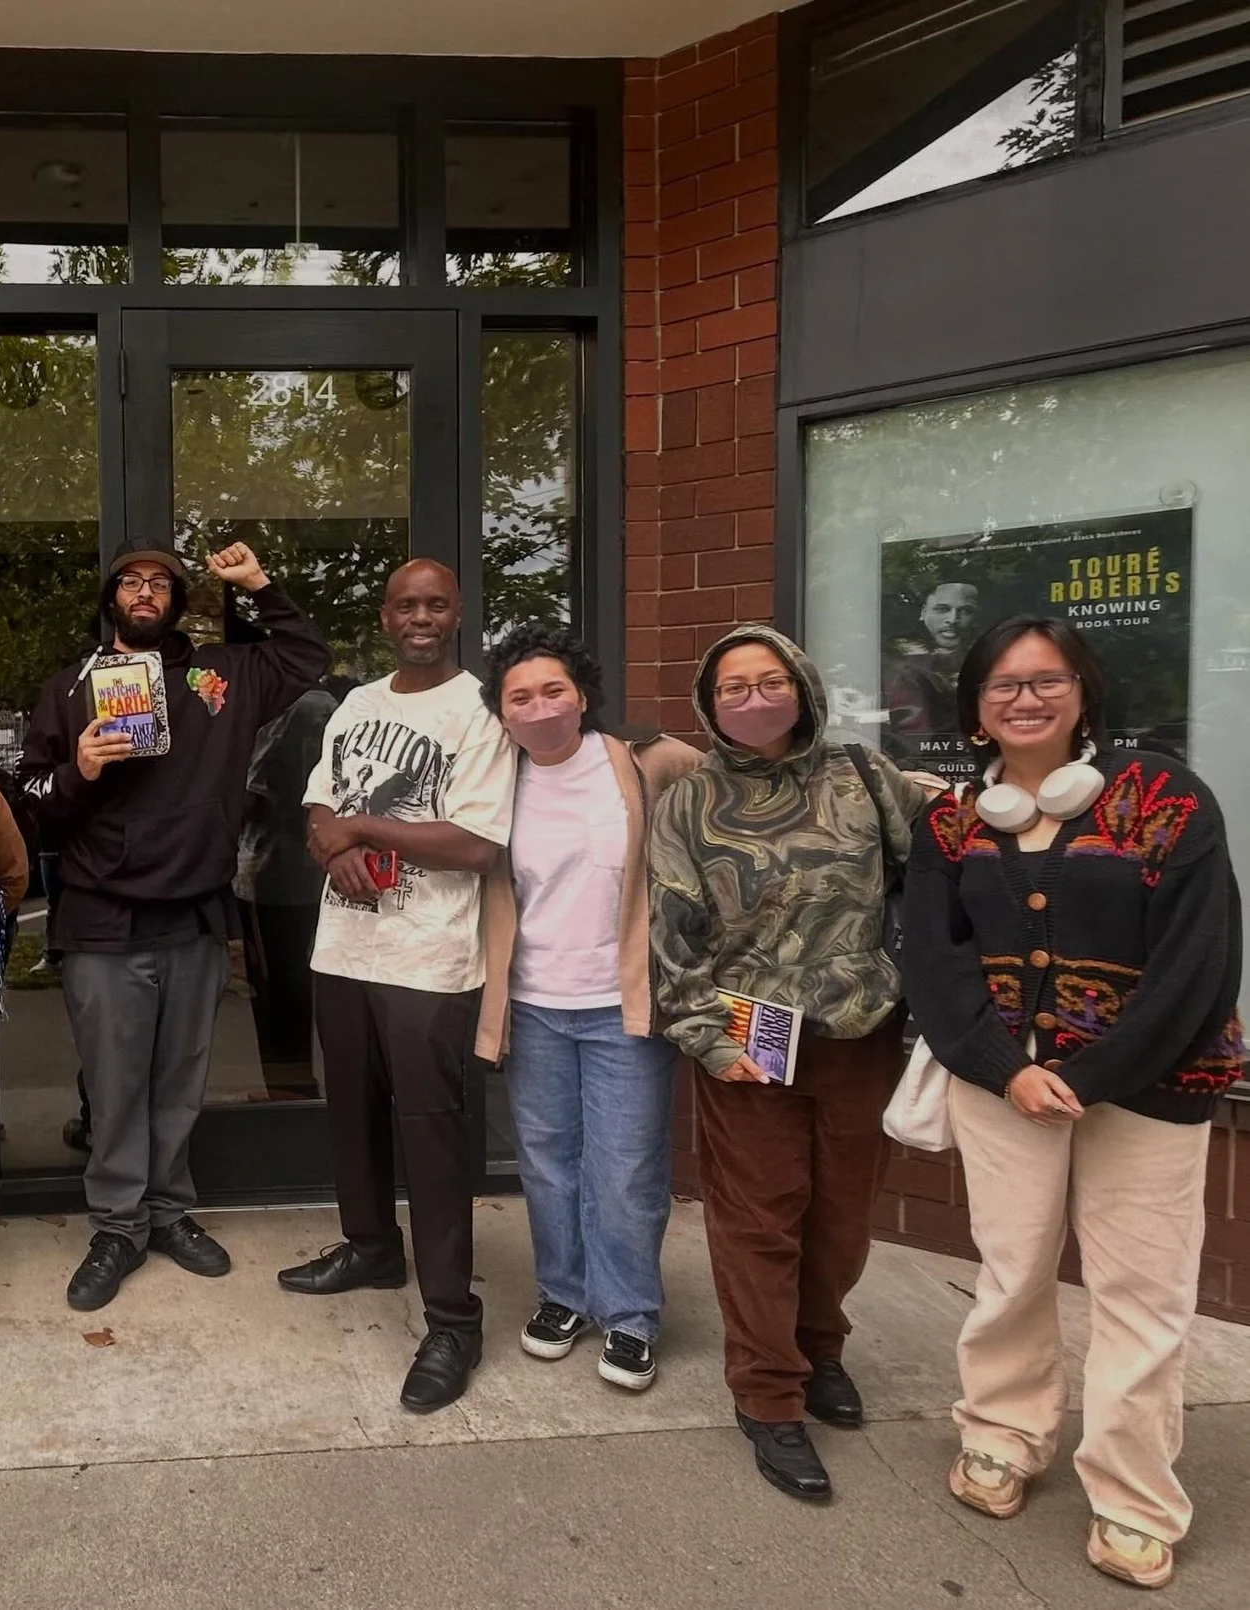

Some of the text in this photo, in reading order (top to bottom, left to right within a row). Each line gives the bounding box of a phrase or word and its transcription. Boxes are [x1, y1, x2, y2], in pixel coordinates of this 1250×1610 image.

[247, 374, 337, 409] 2814
[1069, 545, 1160, 579] TOURÉ
[1050, 571, 1181, 603] ROBERTS
[1067, 599, 1162, 617] KNOWING
[1076, 616, 1150, 629] BOOK TOUR
[109, 693, 152, 716] EARTH
[919, 741, 951, 751] MAY
[1113, 738, 1138, 748] PM
[938, 764, 976, 772] GUILD
